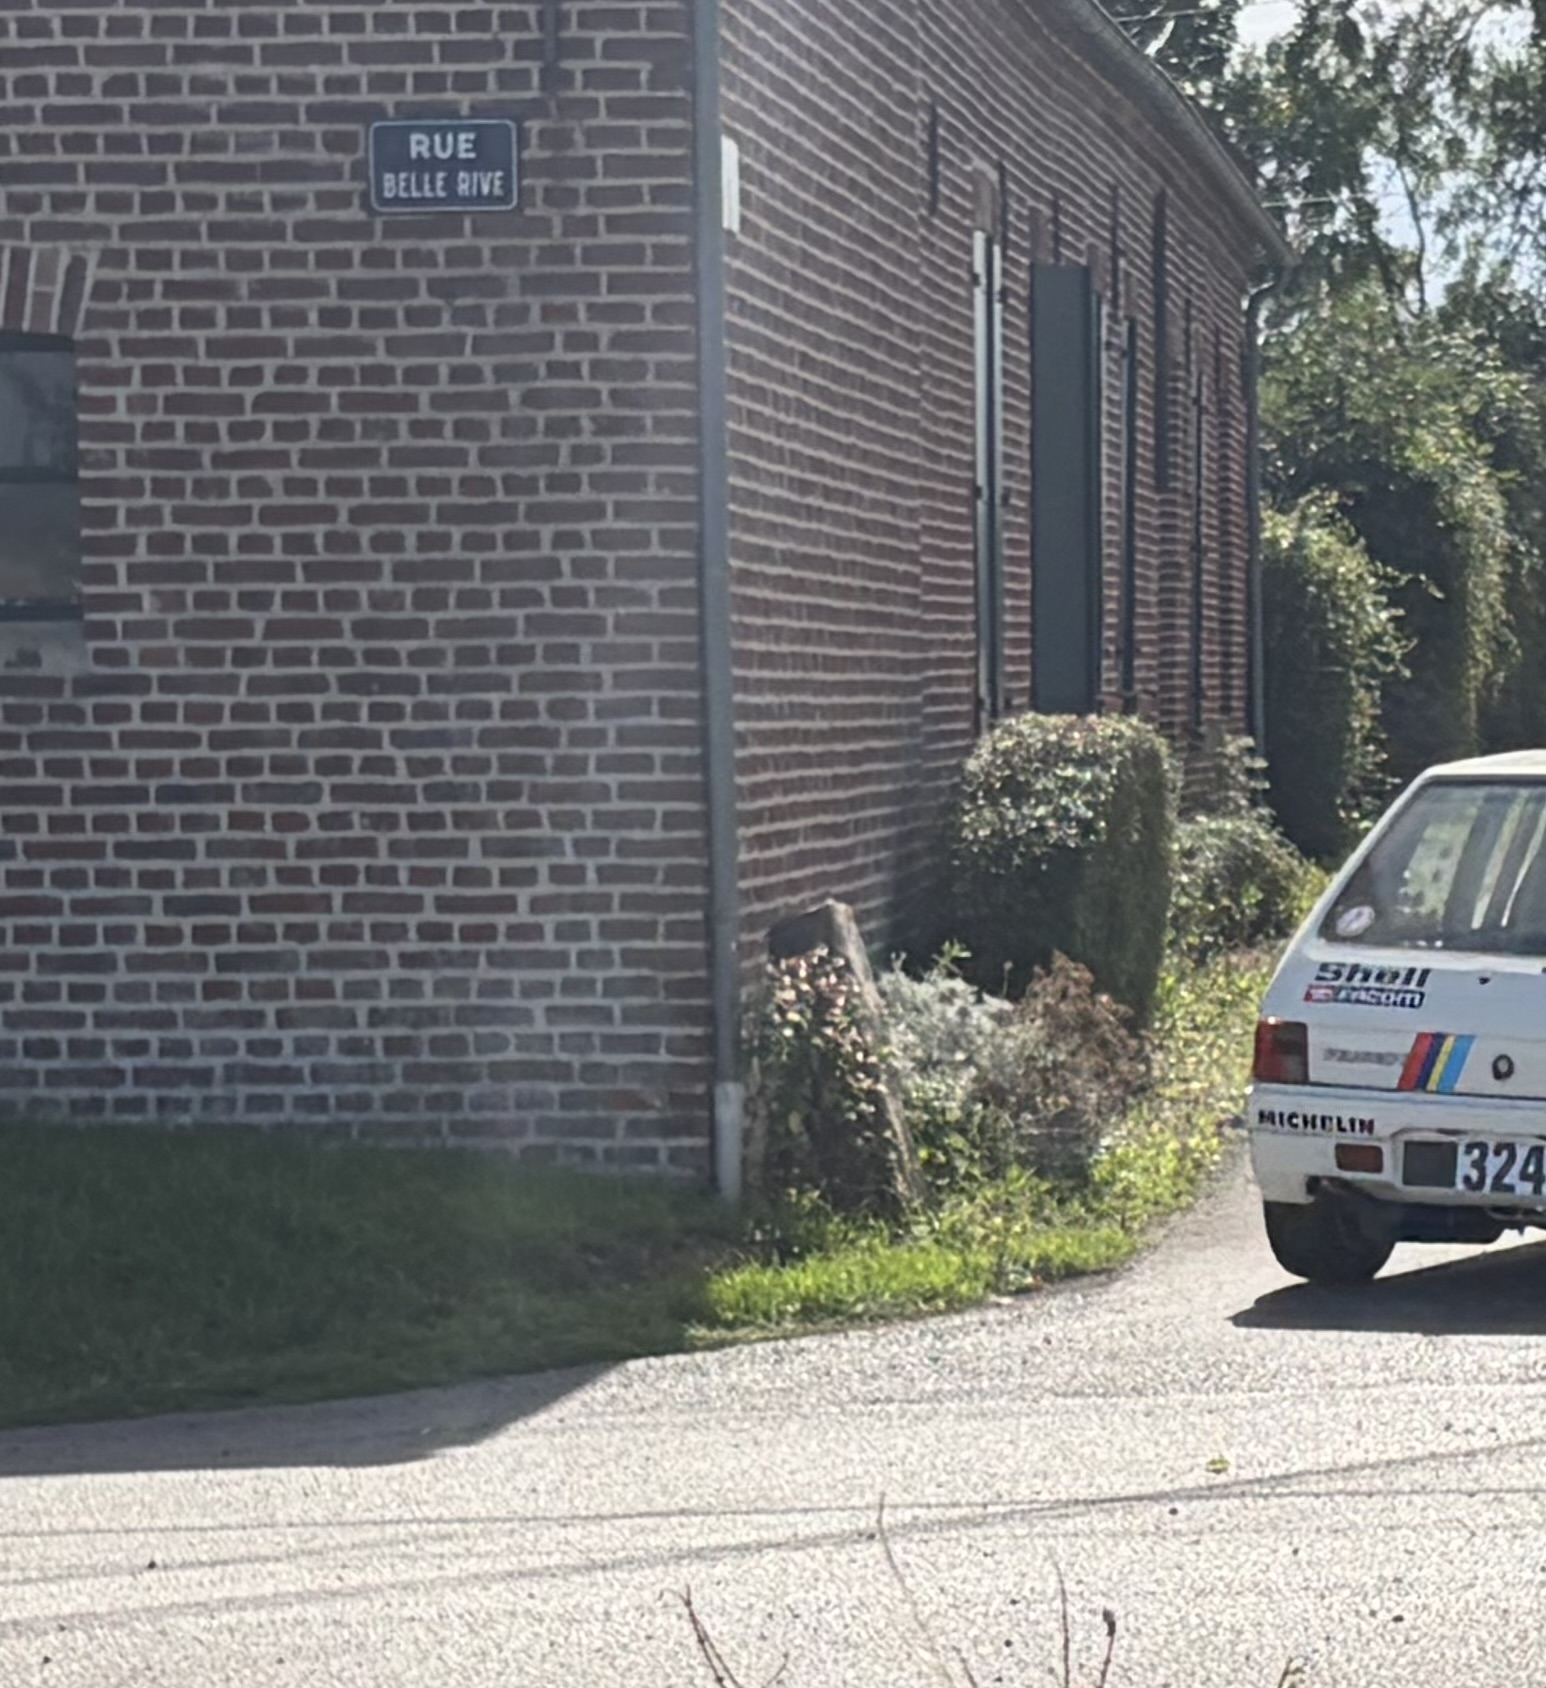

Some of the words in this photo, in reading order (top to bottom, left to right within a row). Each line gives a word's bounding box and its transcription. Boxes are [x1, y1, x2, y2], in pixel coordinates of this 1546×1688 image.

[409, 132, 477, 160] RUE
[383, 171, 448, 199] BELLE
[456, 170, 505, 197] RIVE
[1314, 962, 1432, 988] Shell
[1258, 1109, 1376, 1136] MICHELIN
[1462, 1141, 1546, 1195] 324
